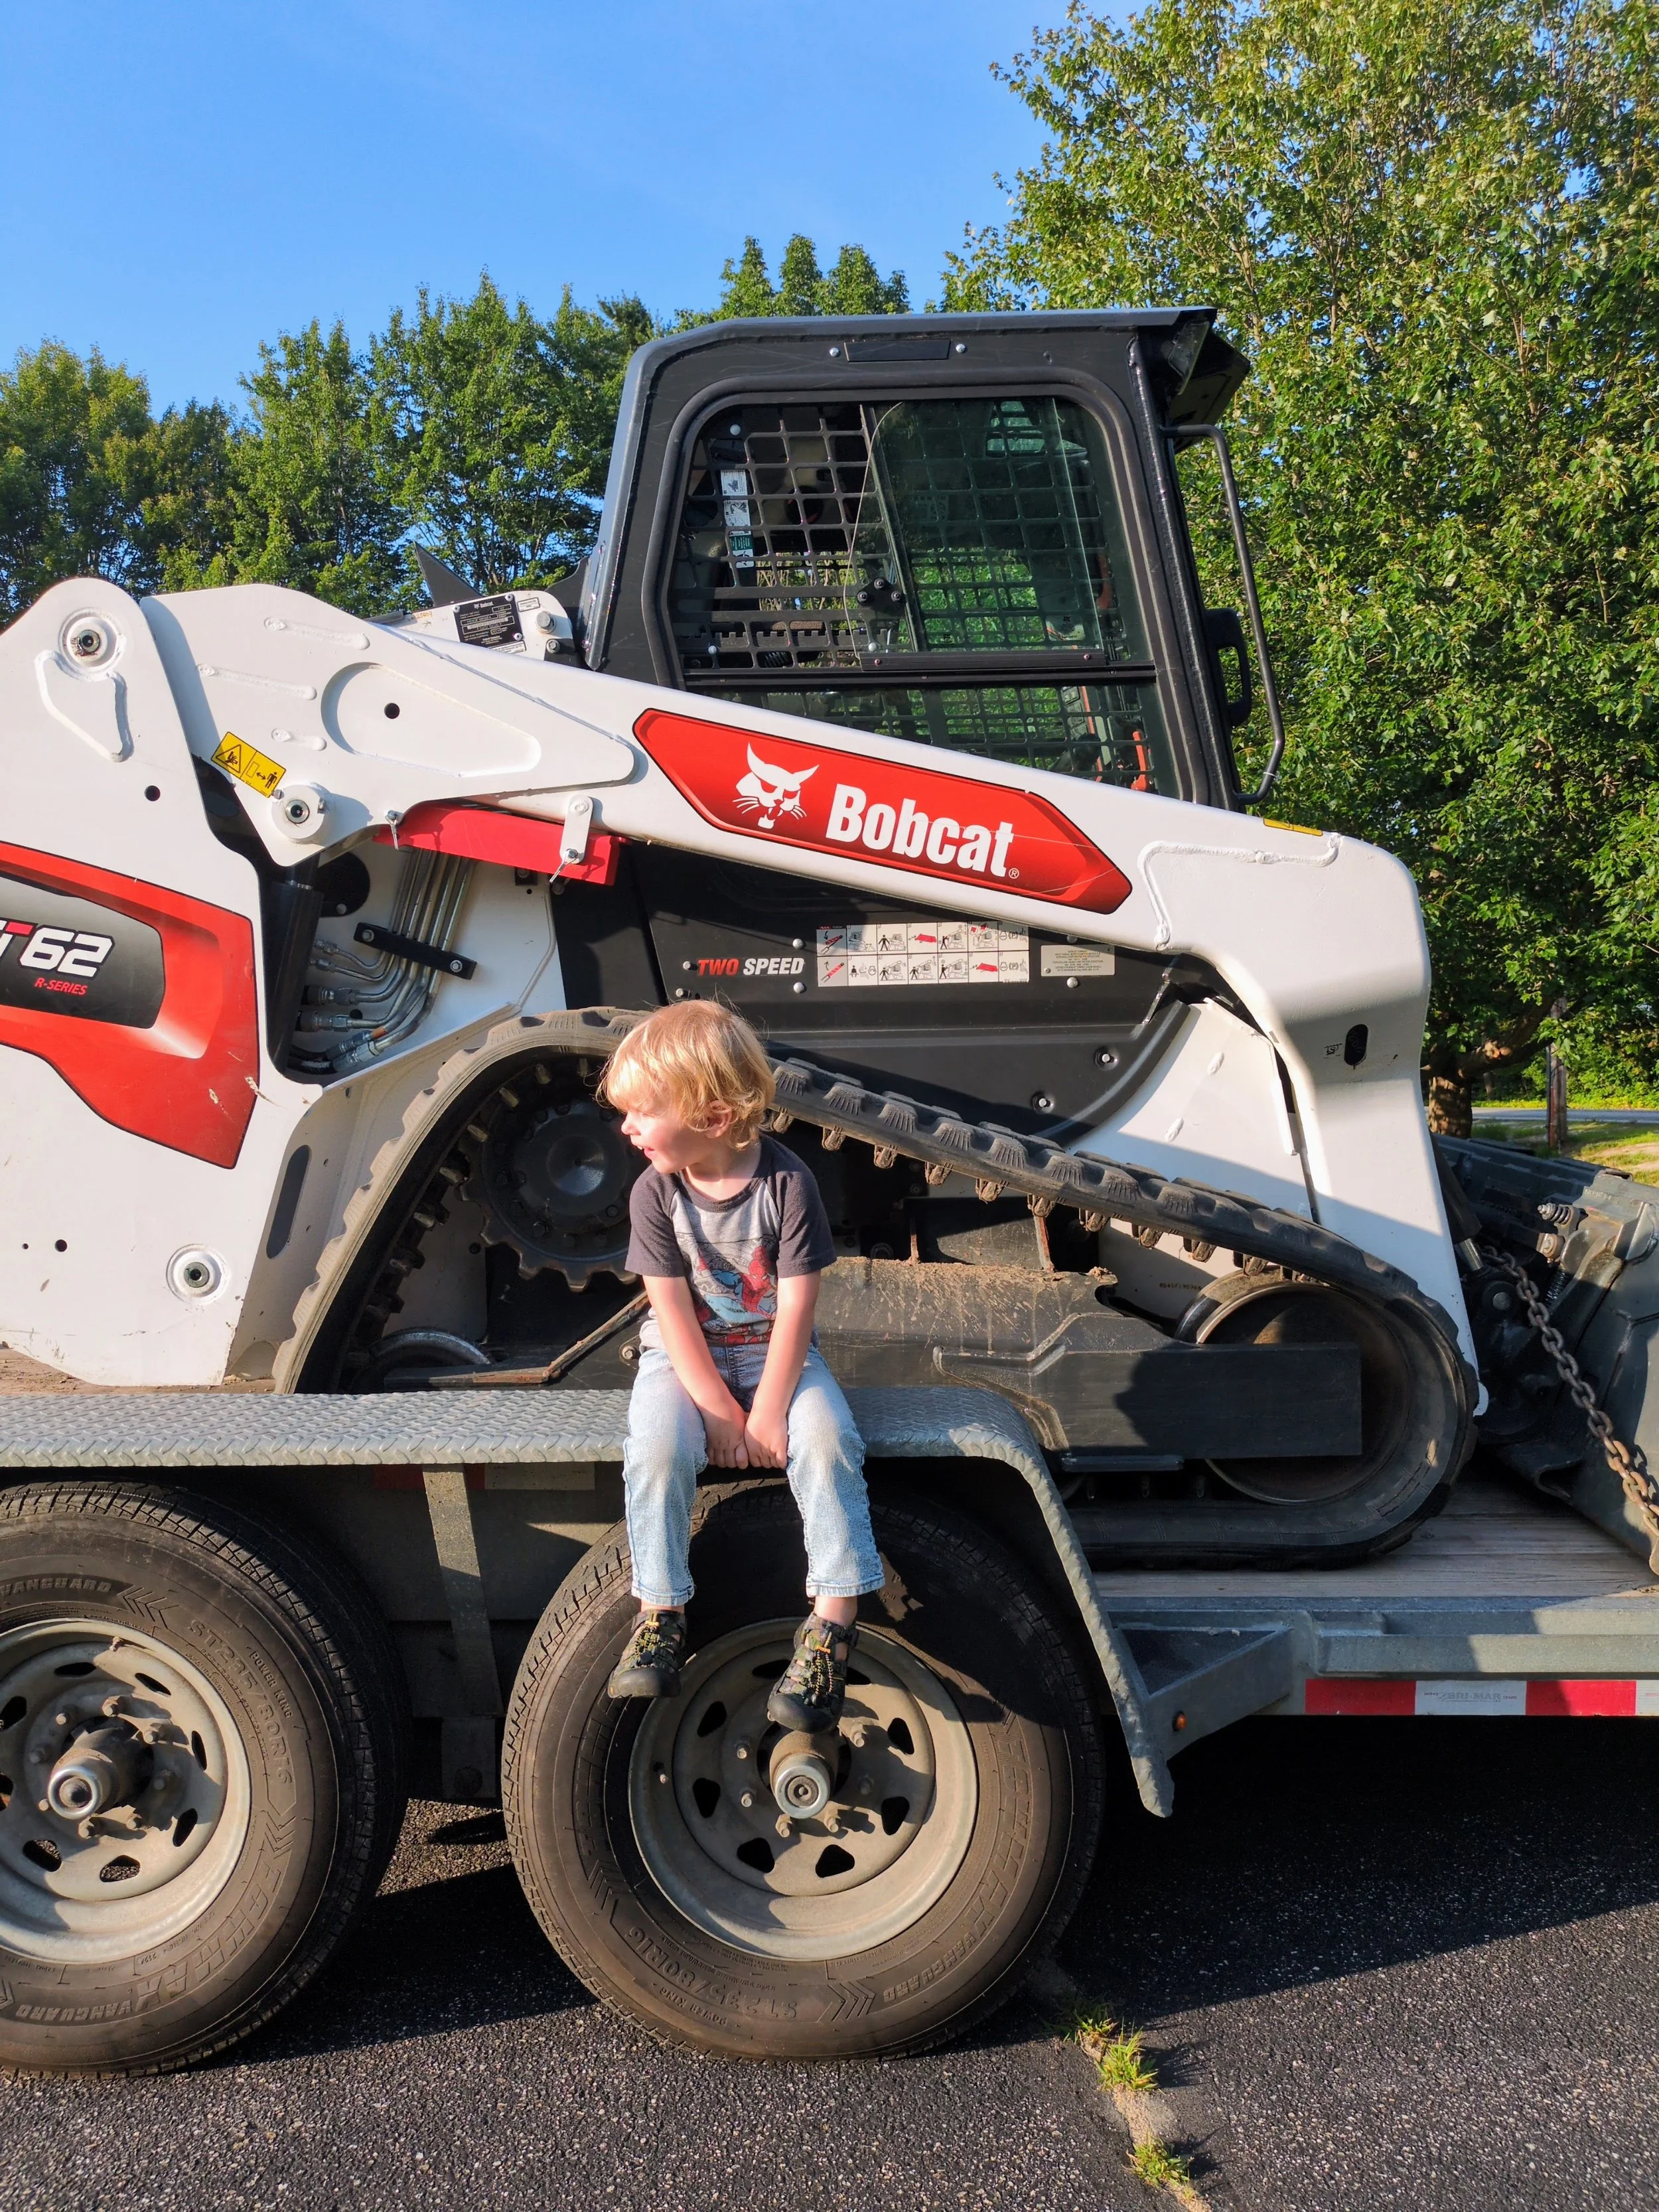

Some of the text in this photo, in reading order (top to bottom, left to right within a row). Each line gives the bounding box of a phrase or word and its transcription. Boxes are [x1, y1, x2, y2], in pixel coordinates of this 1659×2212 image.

[826, 784, 1014, 877] Bobcat
[35, 978, 88, 995] R-SERIES
[698, 958, 805, 976] TWO SPEED
[188, 1619, 292, 1784] ST235/80R16
[250, 1651, 293, 1718] POWER KING
[625, 1927, 797, 2018] ST235/80R16
[884, 1933, 976, 2002] VANGUARD
[15, 1999, 132, 2020] VANGUARD
[660, 1987, 727, 2026] POWER KING
